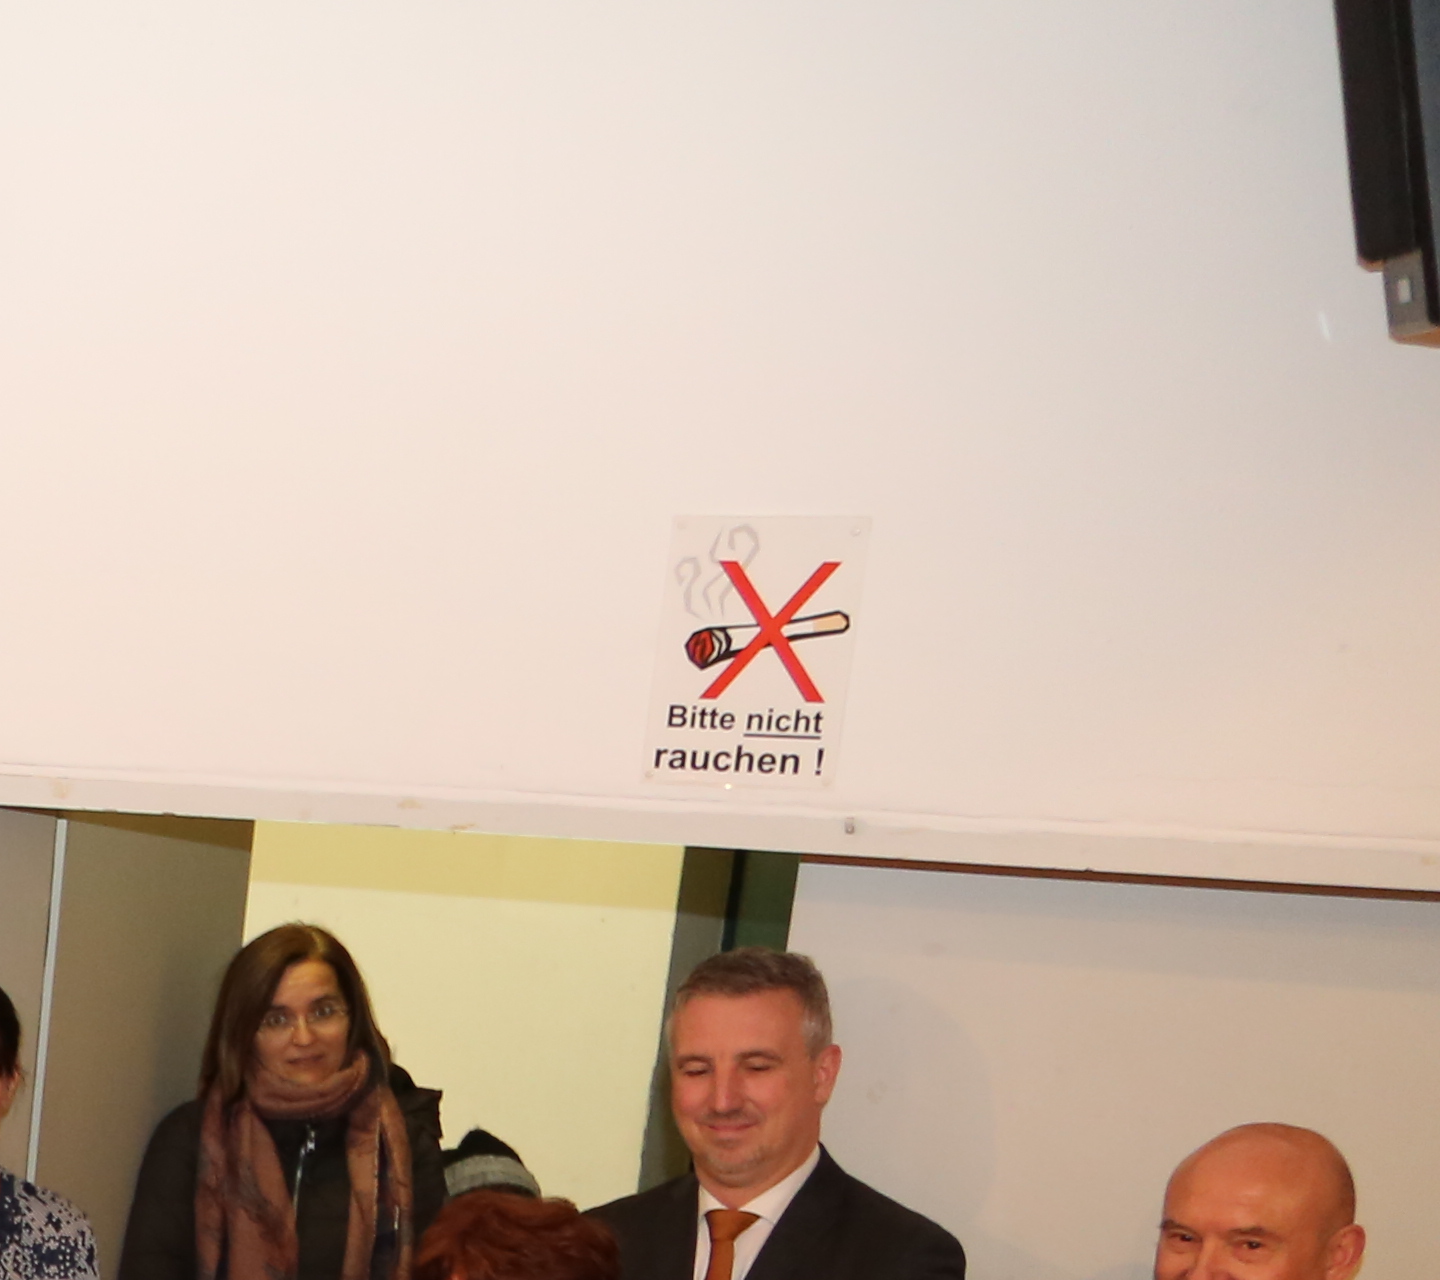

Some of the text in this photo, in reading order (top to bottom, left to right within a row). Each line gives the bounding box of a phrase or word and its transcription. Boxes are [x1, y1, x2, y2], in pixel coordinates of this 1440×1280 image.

[667, 704, 823, 735] Bitte nicht
[653, 744, 824, 775] rauchen !
